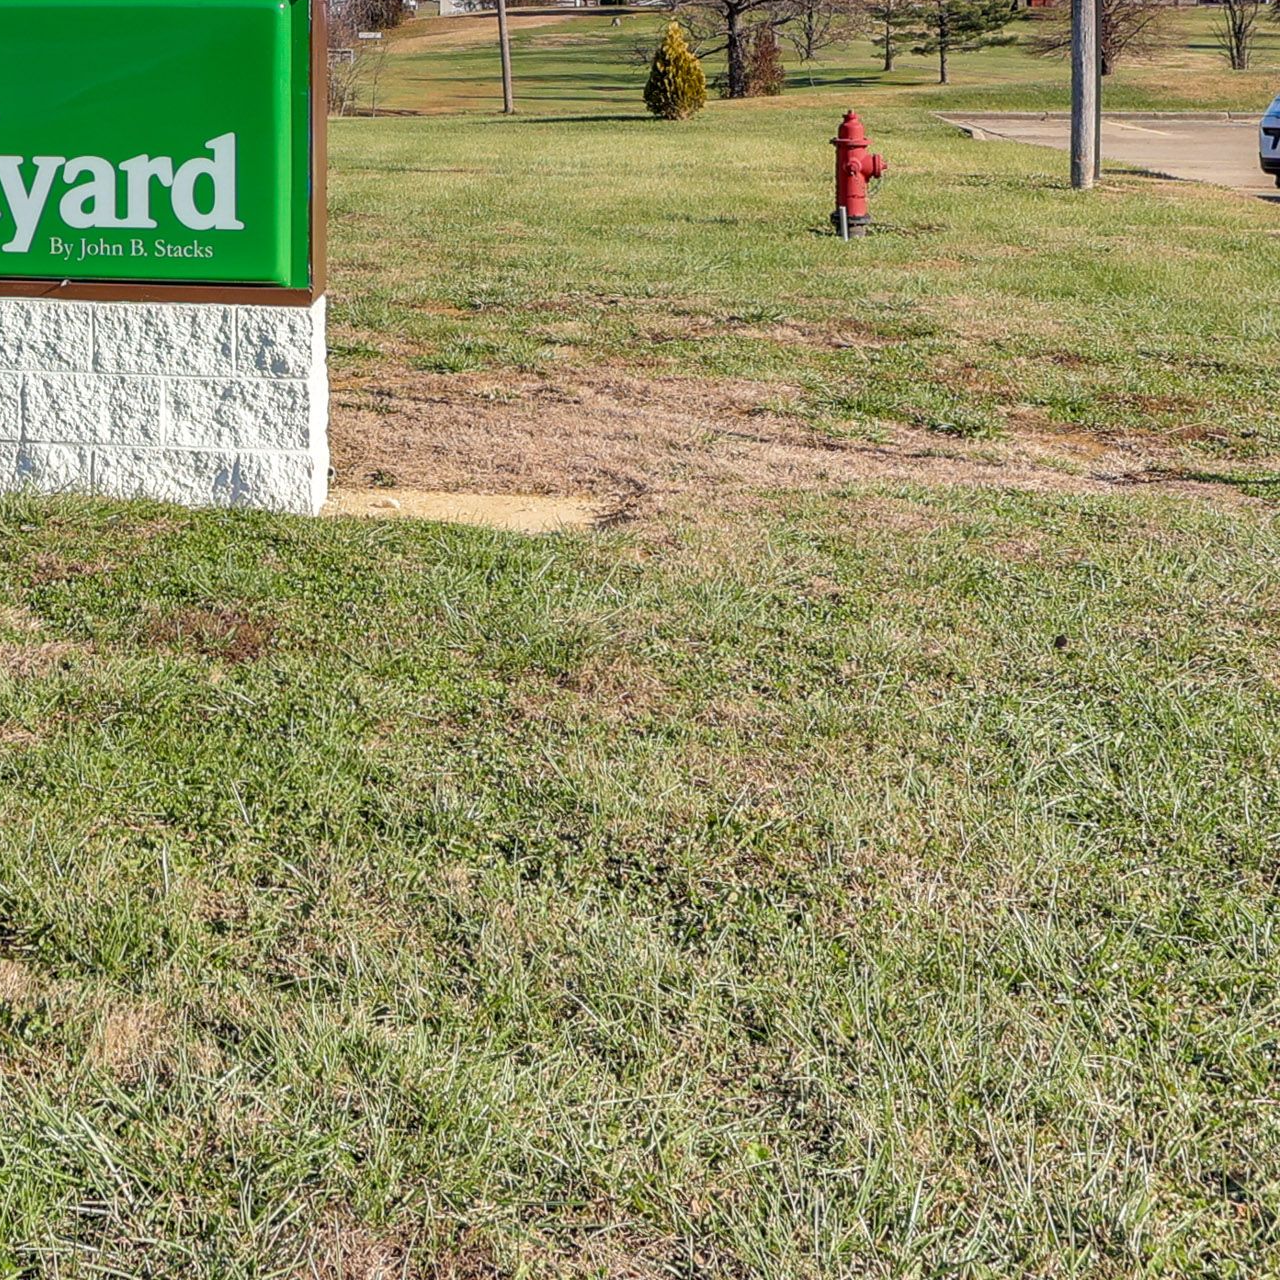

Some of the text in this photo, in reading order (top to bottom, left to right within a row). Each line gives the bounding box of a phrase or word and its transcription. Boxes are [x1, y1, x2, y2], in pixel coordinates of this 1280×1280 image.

[49, 237, 214, 261] By John B. Stacks
